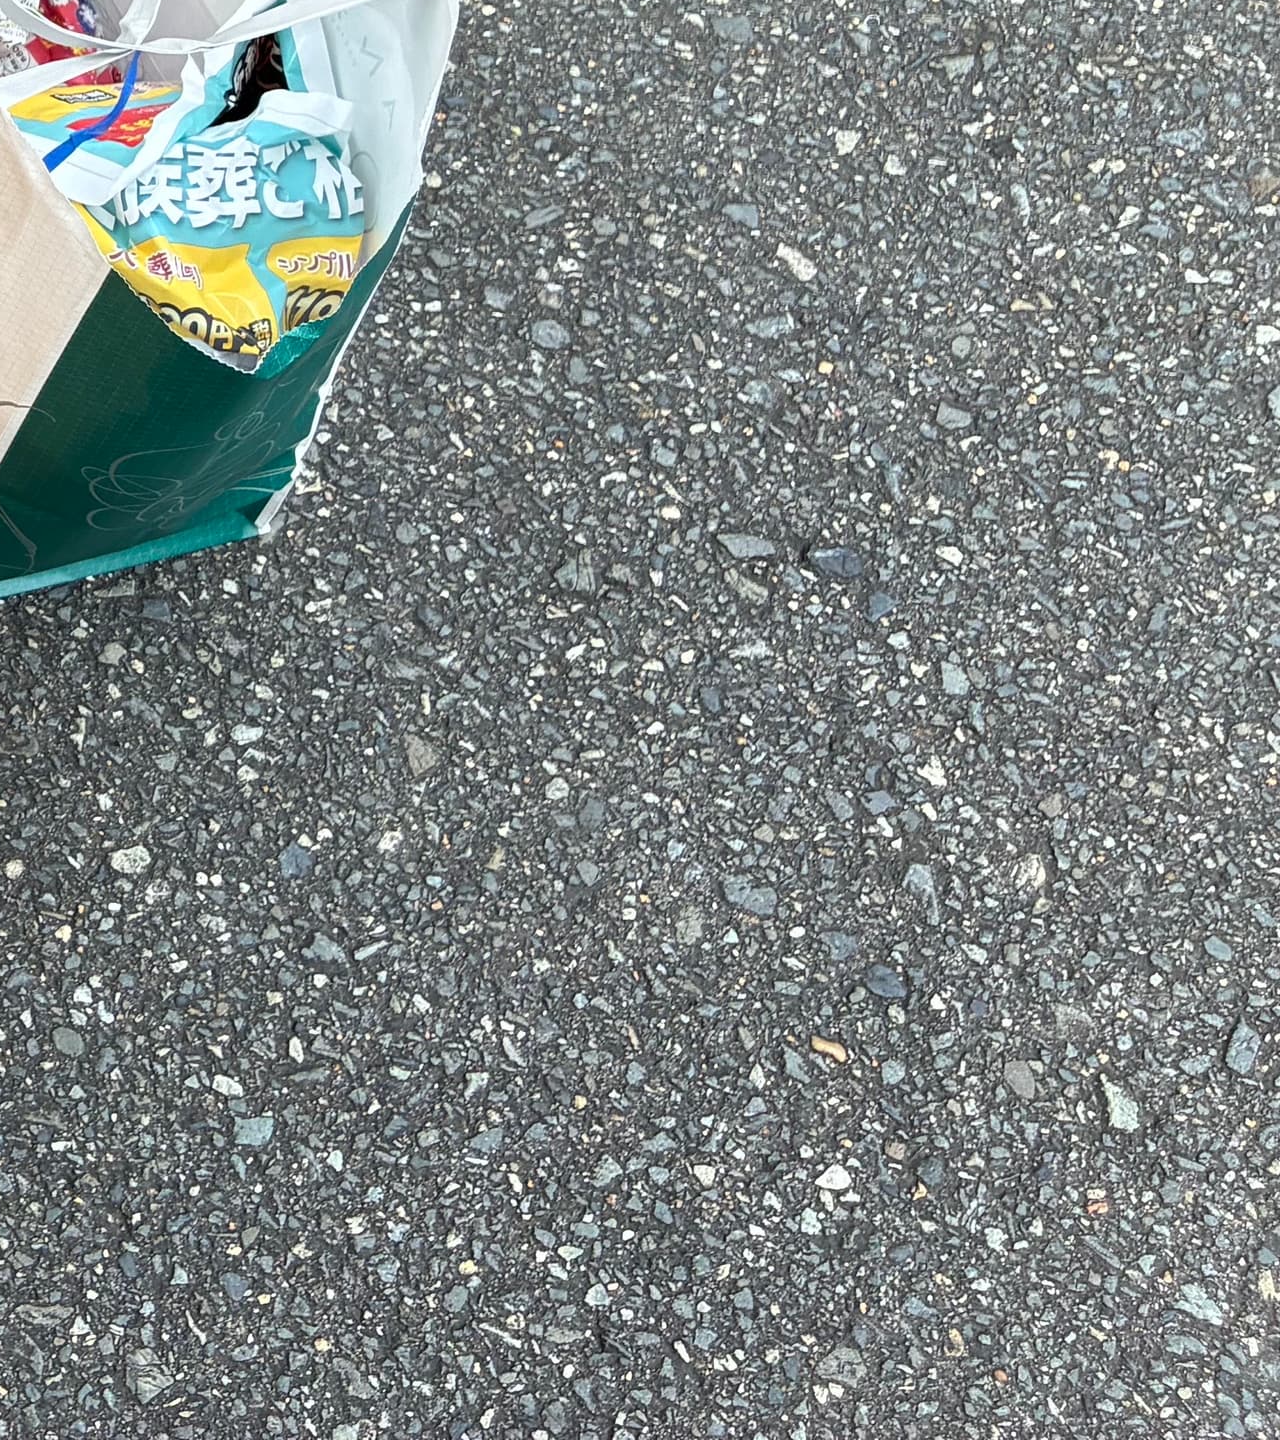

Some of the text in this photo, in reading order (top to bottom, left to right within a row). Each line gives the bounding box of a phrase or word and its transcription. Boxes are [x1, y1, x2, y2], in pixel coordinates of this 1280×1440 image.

[100, 138, 365, 229] 族葬ご相
[277, 252, 355, 280] シンプル
